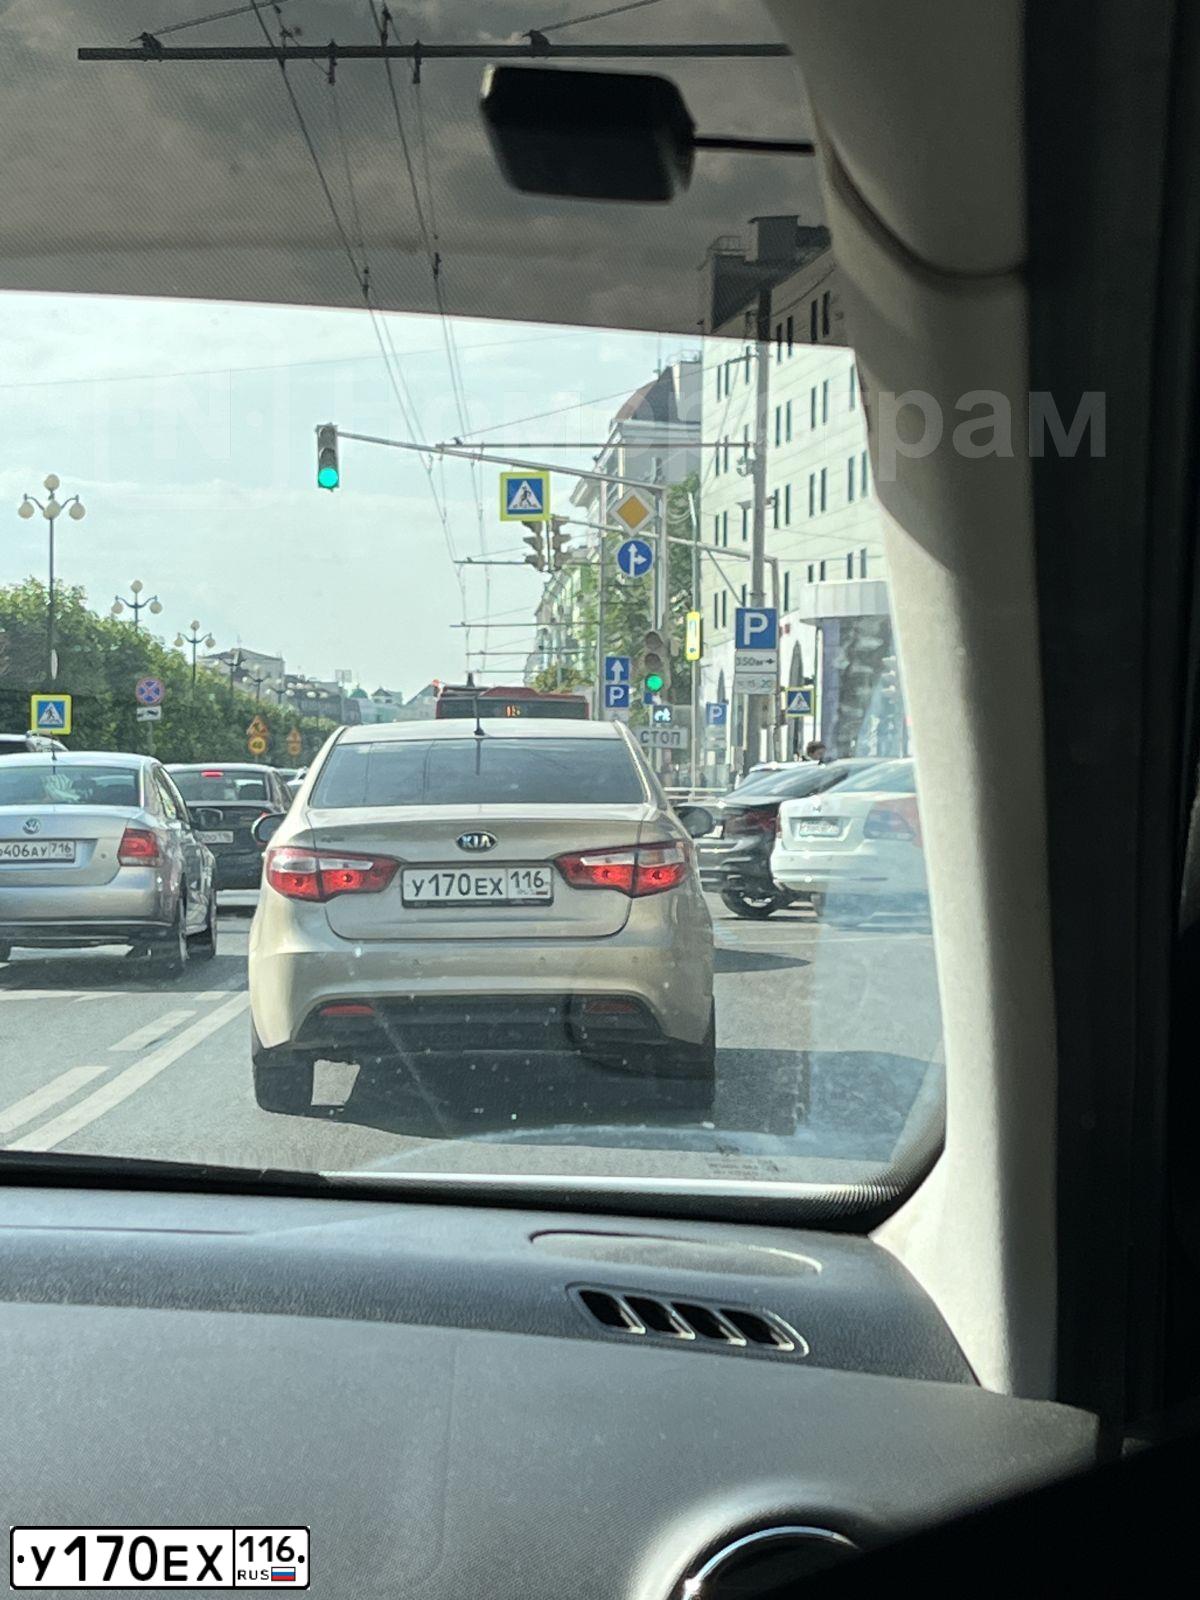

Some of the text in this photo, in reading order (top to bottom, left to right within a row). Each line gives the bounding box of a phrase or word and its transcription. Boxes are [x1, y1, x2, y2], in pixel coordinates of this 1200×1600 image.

[743, 612, 768, 645] P
[610, 686, 624, 706] P
[709, 706, 723, 723] P
[641, 730, 680, 745] СТОП
[51, 843, 71, 853] 716
[461, 835, 492, 848] KIA
[412, 871, 544, 897] У170ЕХ 116
